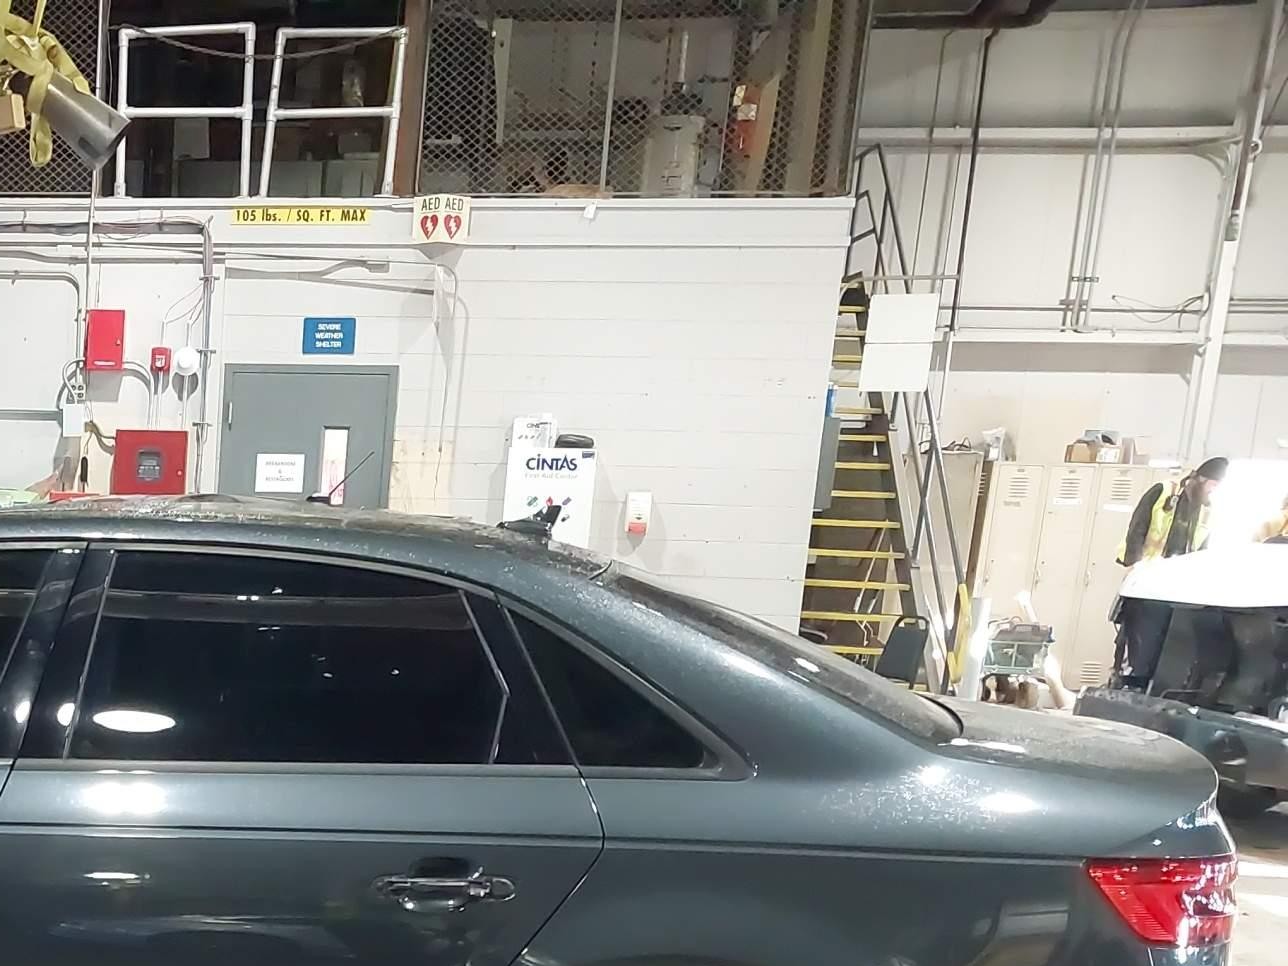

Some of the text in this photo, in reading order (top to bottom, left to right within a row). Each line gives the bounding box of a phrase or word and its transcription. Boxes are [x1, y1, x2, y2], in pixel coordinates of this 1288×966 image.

[420, 197, 440, 212] AED
[444, 197, 464, 212] AED
[235, 208, 257, 222] 105
[261, 208, 282, 222] lbs.
[296, 208, 314, 223] SQ.
[319, 208, 335, 222] FT.
[340, 208, 367, 222] MAX
[317, 323, 342, 331] SEVERE
[314, 331, 344, 340] WEATHER
[315, 340, 342, 348] SHELTER
